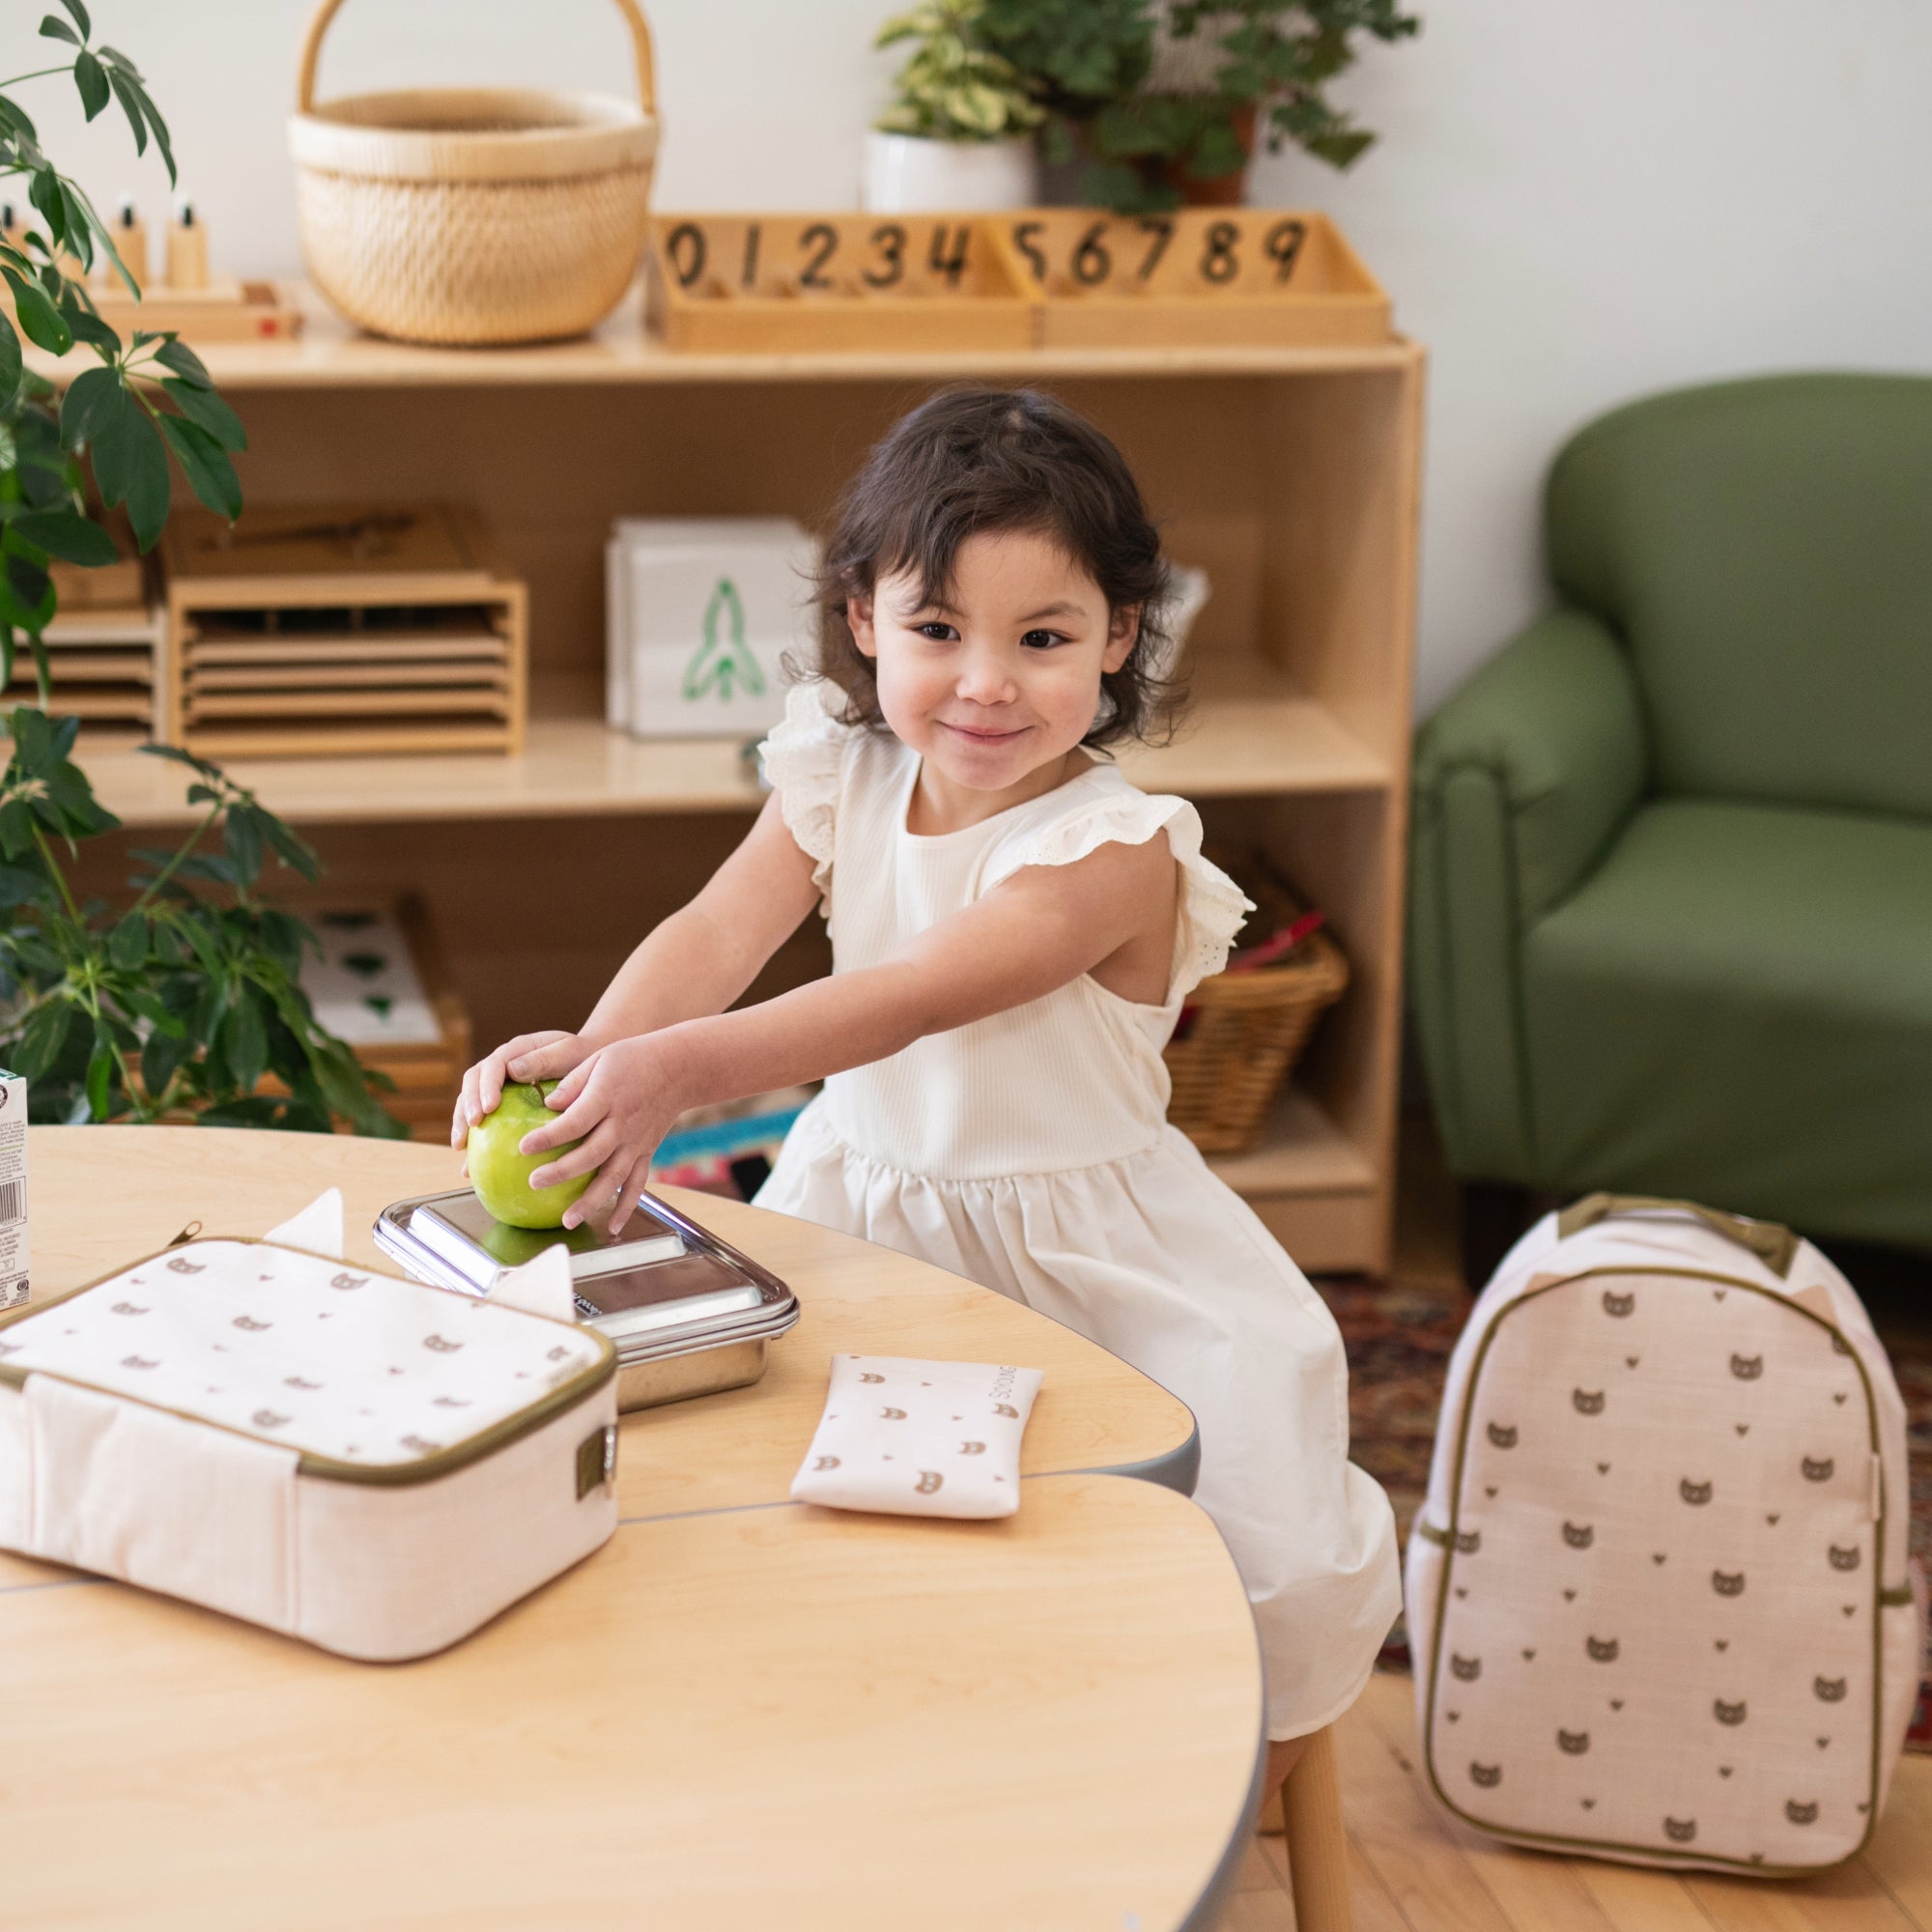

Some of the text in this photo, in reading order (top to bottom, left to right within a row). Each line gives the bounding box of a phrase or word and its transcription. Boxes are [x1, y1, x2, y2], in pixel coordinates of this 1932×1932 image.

[667, 221, 972, 289] 0 1 2 3 4
[1069, 221, 1112, 286] 6
[1137, 218, 1174, 283] 7
[1198, 220, 1241, 285] 8
[1262, 219, 1306, 286] 9
